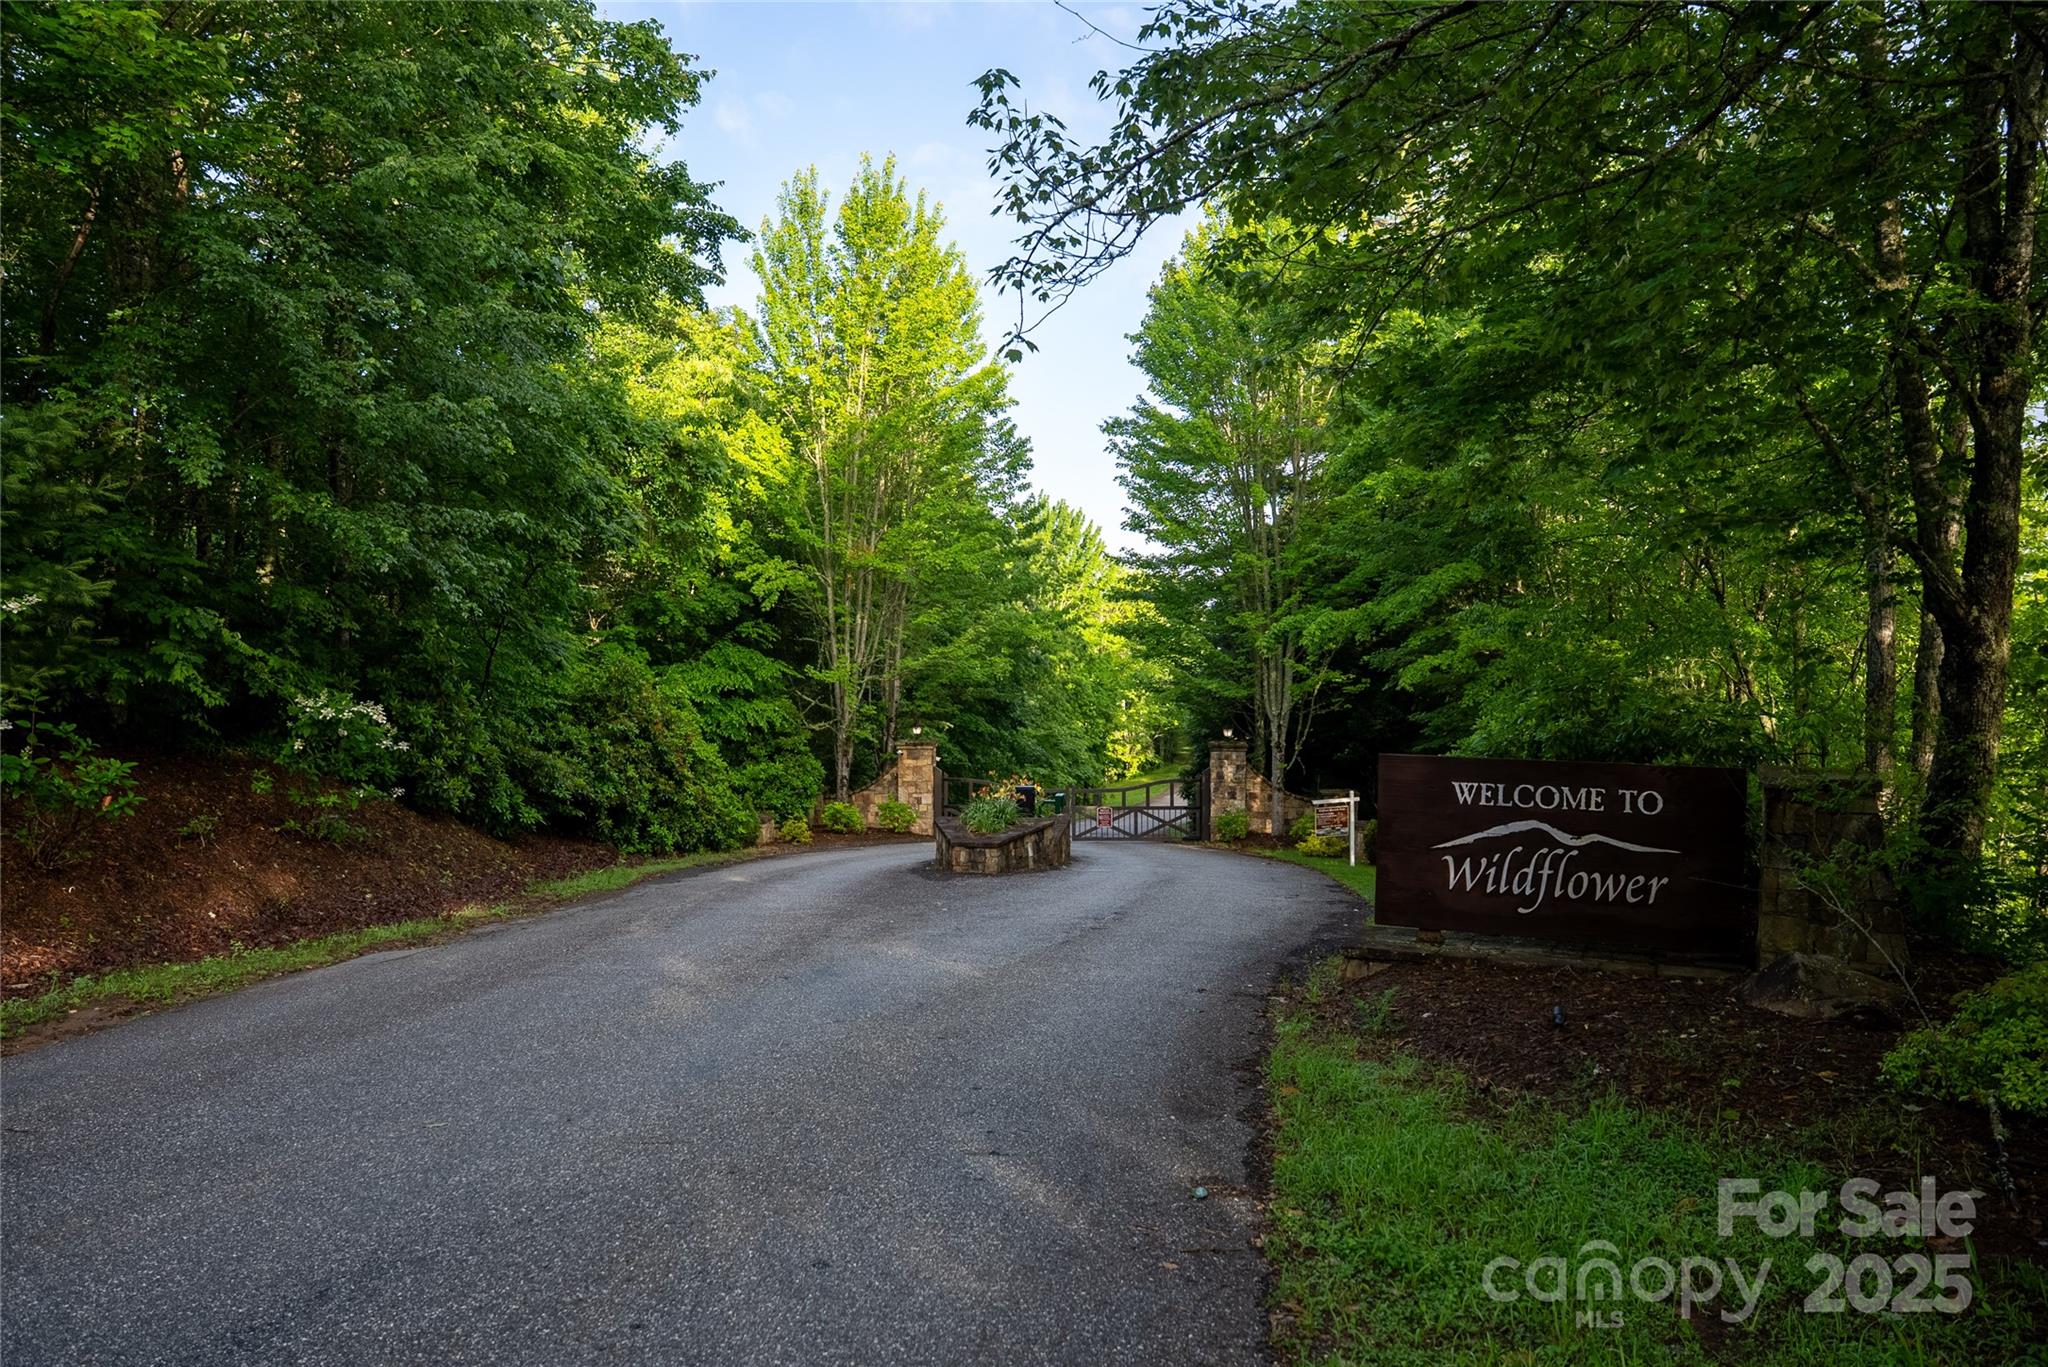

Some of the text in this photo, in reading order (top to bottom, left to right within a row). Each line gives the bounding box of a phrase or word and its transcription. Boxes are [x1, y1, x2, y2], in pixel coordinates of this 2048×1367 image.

[1450, 781, 1664, 815] WELCOME TO
[1440, 846, 1670, 914] Wildflower
